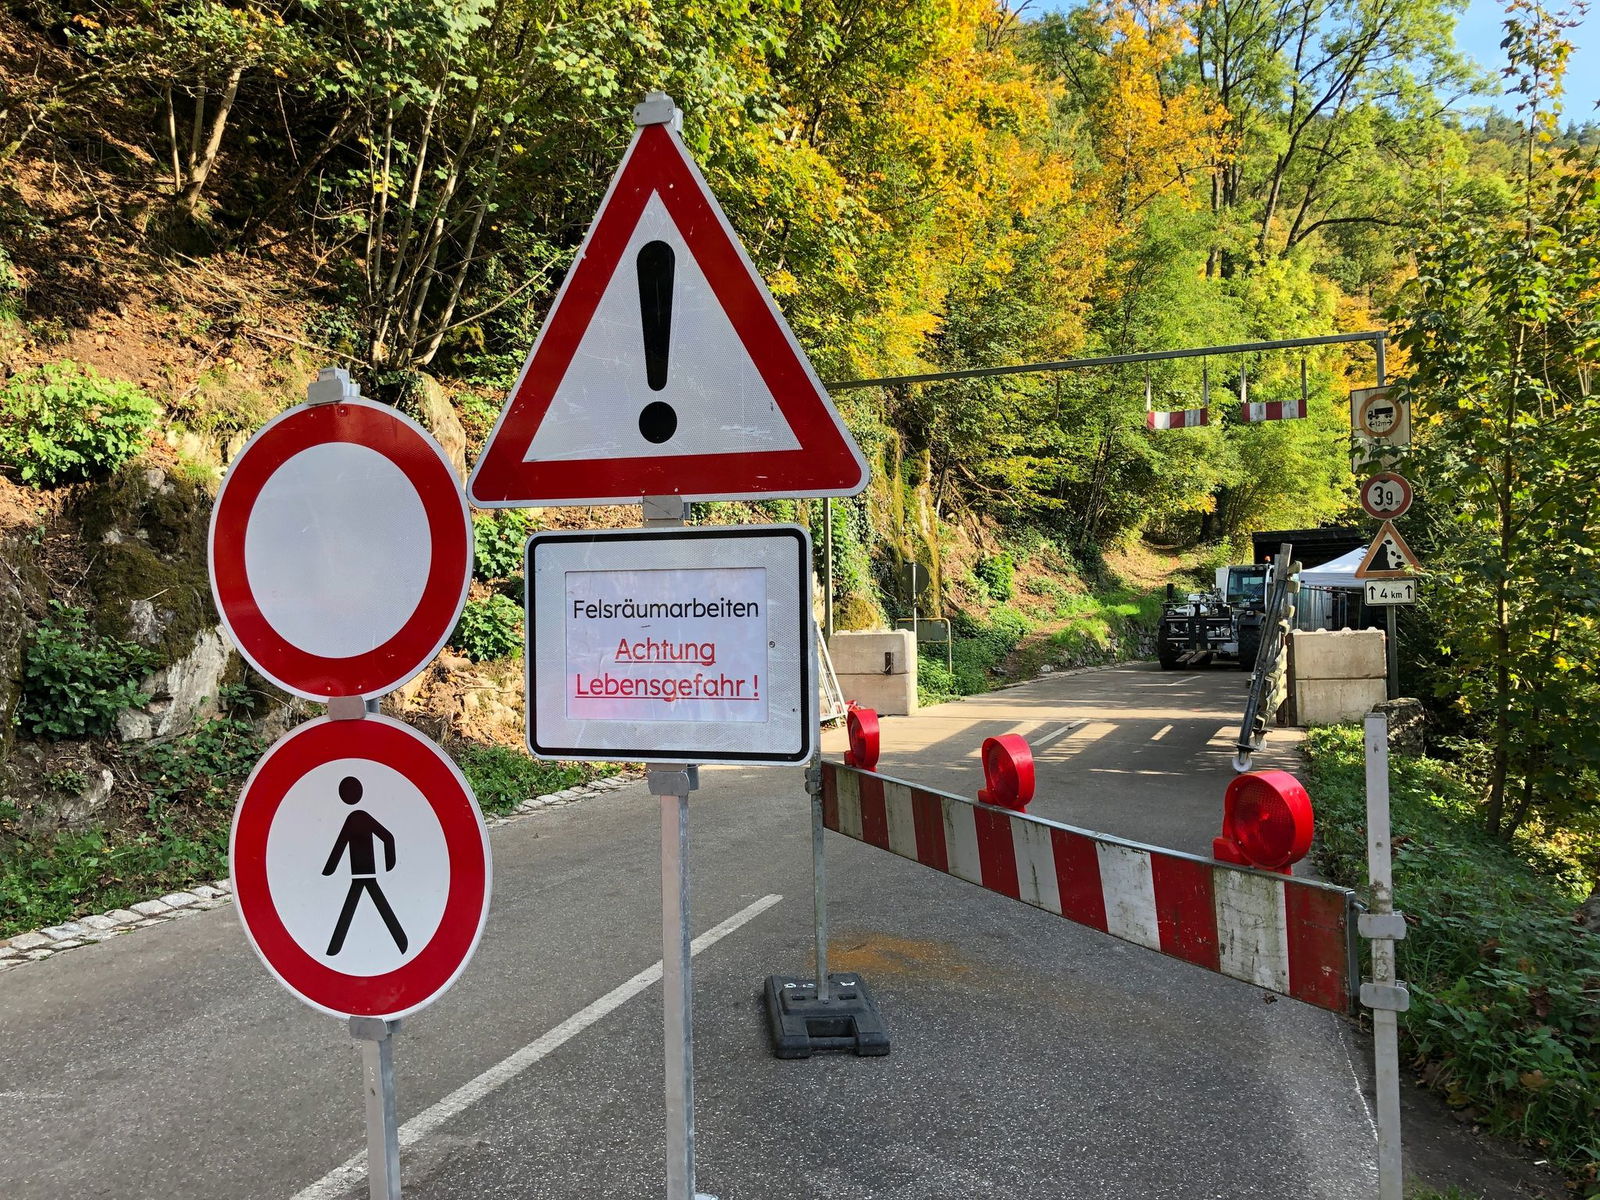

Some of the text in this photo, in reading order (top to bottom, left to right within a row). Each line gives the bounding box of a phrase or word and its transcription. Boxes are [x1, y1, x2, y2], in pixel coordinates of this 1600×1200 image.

[1380, 588, 1403, 599] 4 km
[573, 597, 759, 619] Felsräumarbeiten
[614, 637, 716, 666] Achtung
[575, 672, 745, 702] Lebensgefahr
